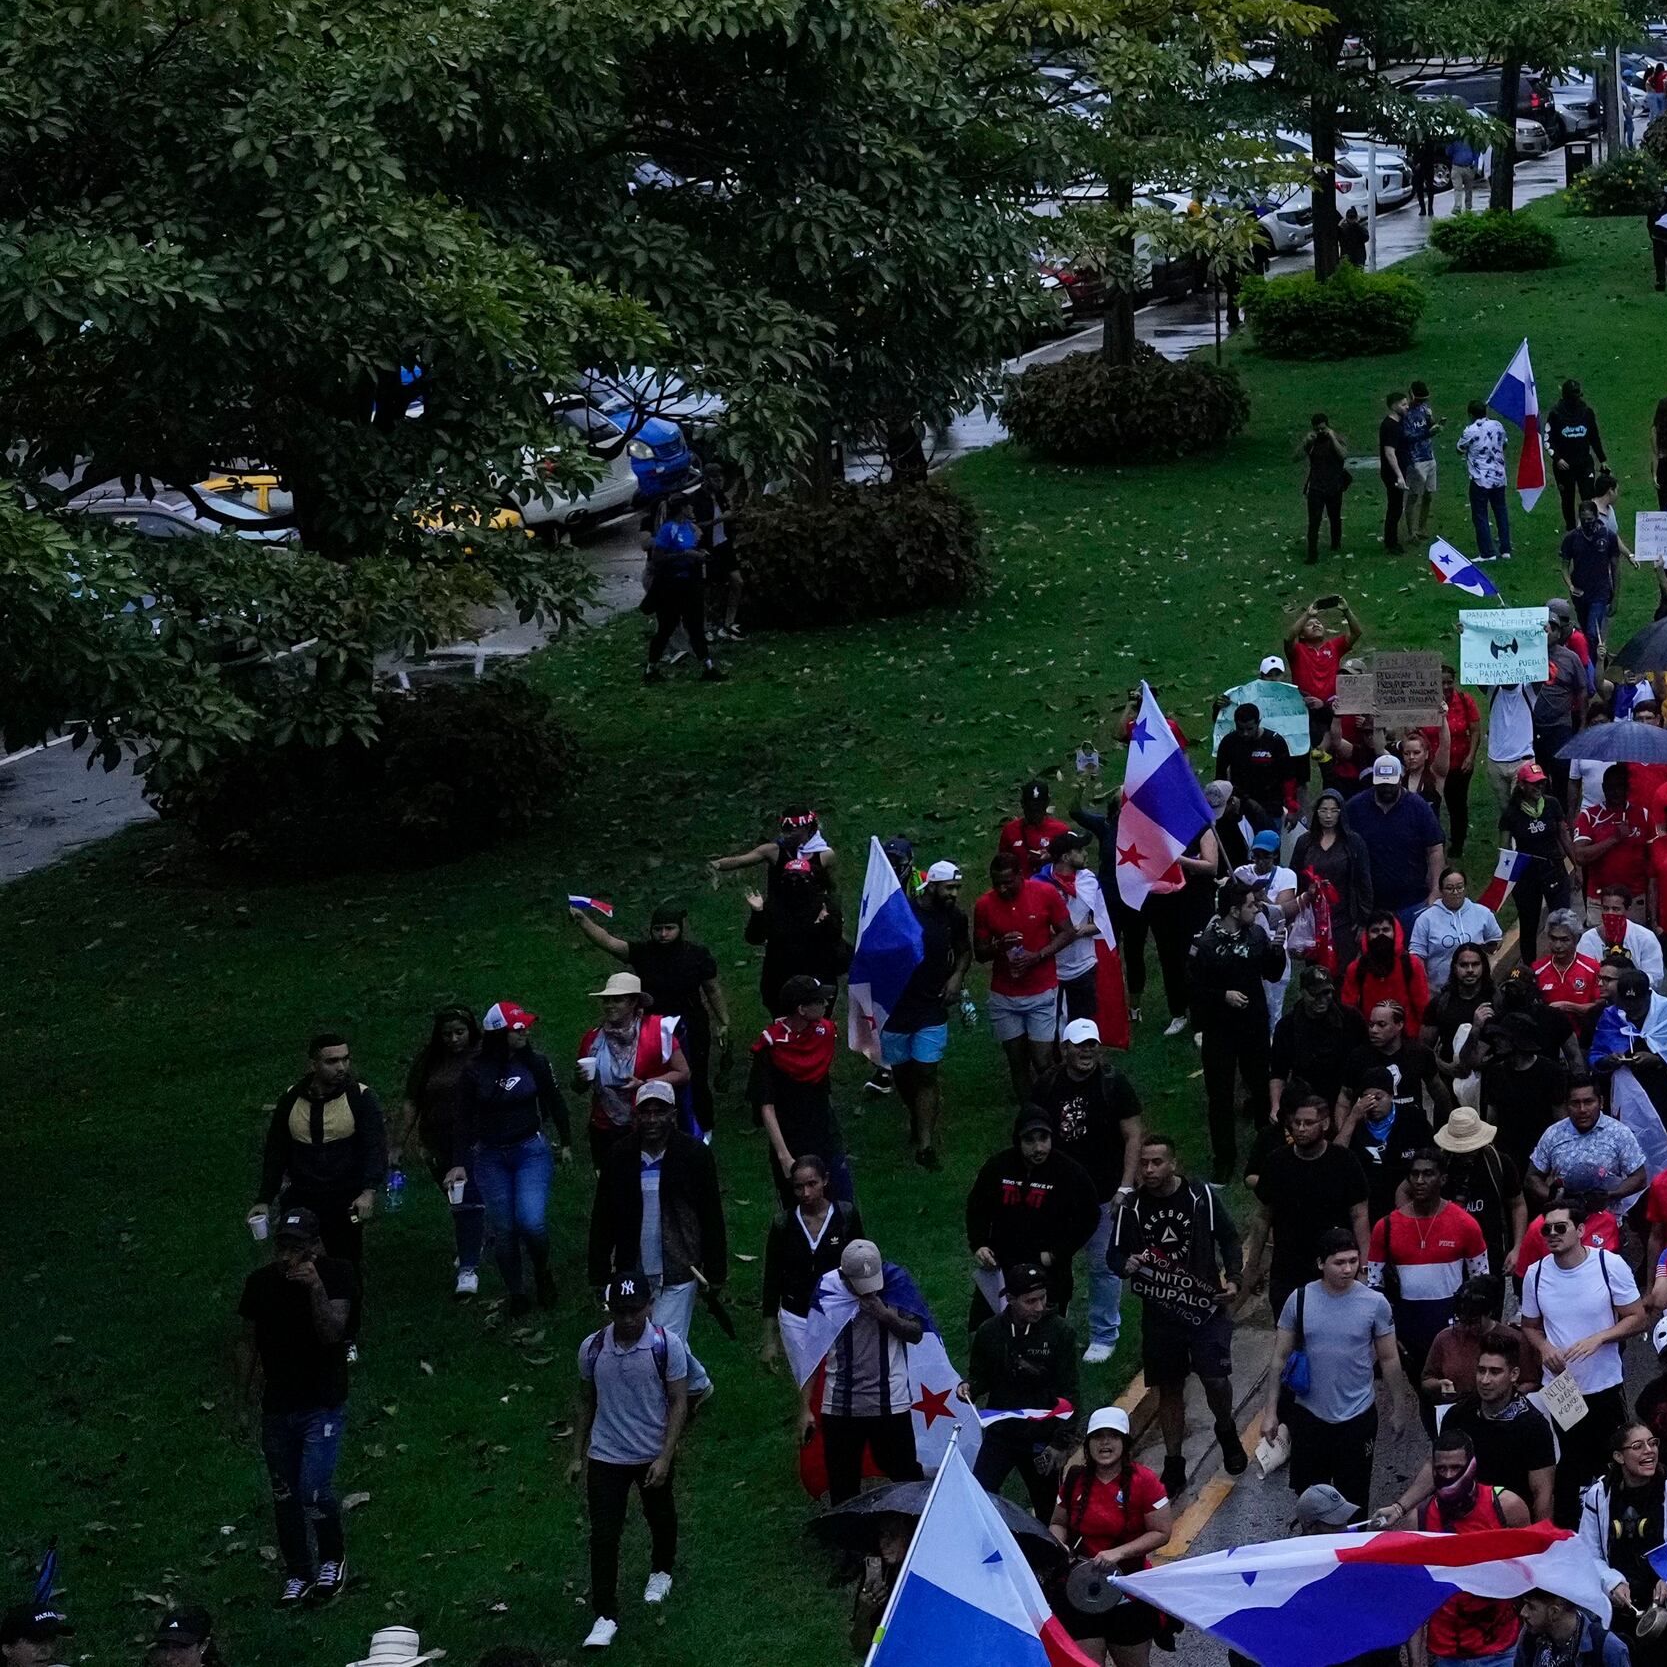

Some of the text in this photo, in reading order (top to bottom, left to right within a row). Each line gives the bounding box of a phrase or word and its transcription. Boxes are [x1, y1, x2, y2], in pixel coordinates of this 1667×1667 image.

[1144, 1209, 1192, 1231] REEBOK
[621, 1280, 635, 1295] NY
[1155, 1270, 1193, 1288] NITO
[1133, 1282, 1210, 1309] CHUPALO
